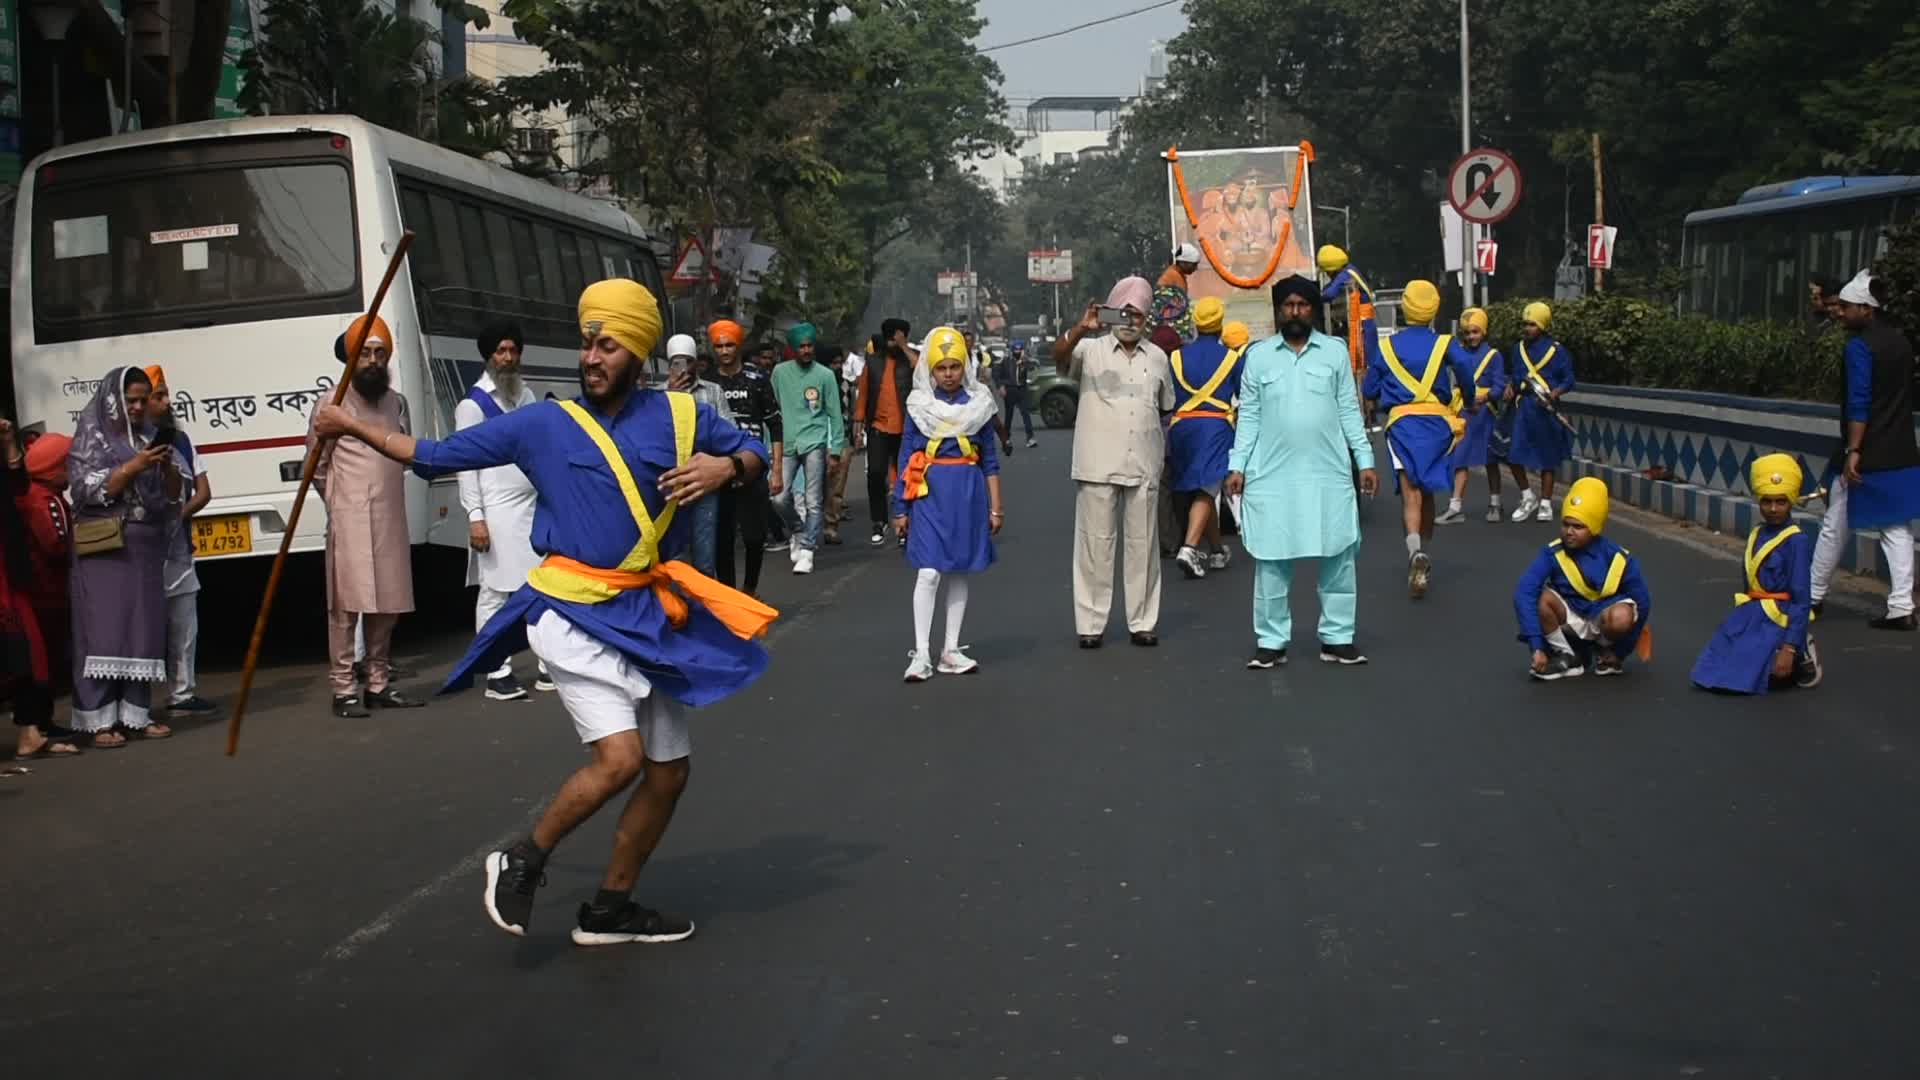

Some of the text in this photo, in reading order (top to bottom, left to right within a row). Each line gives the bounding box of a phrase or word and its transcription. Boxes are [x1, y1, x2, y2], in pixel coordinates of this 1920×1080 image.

[1478, 244, 1491, 268] 7
[225, 520, 239, 534] 19
[212, 535, 245, 550] 4792
